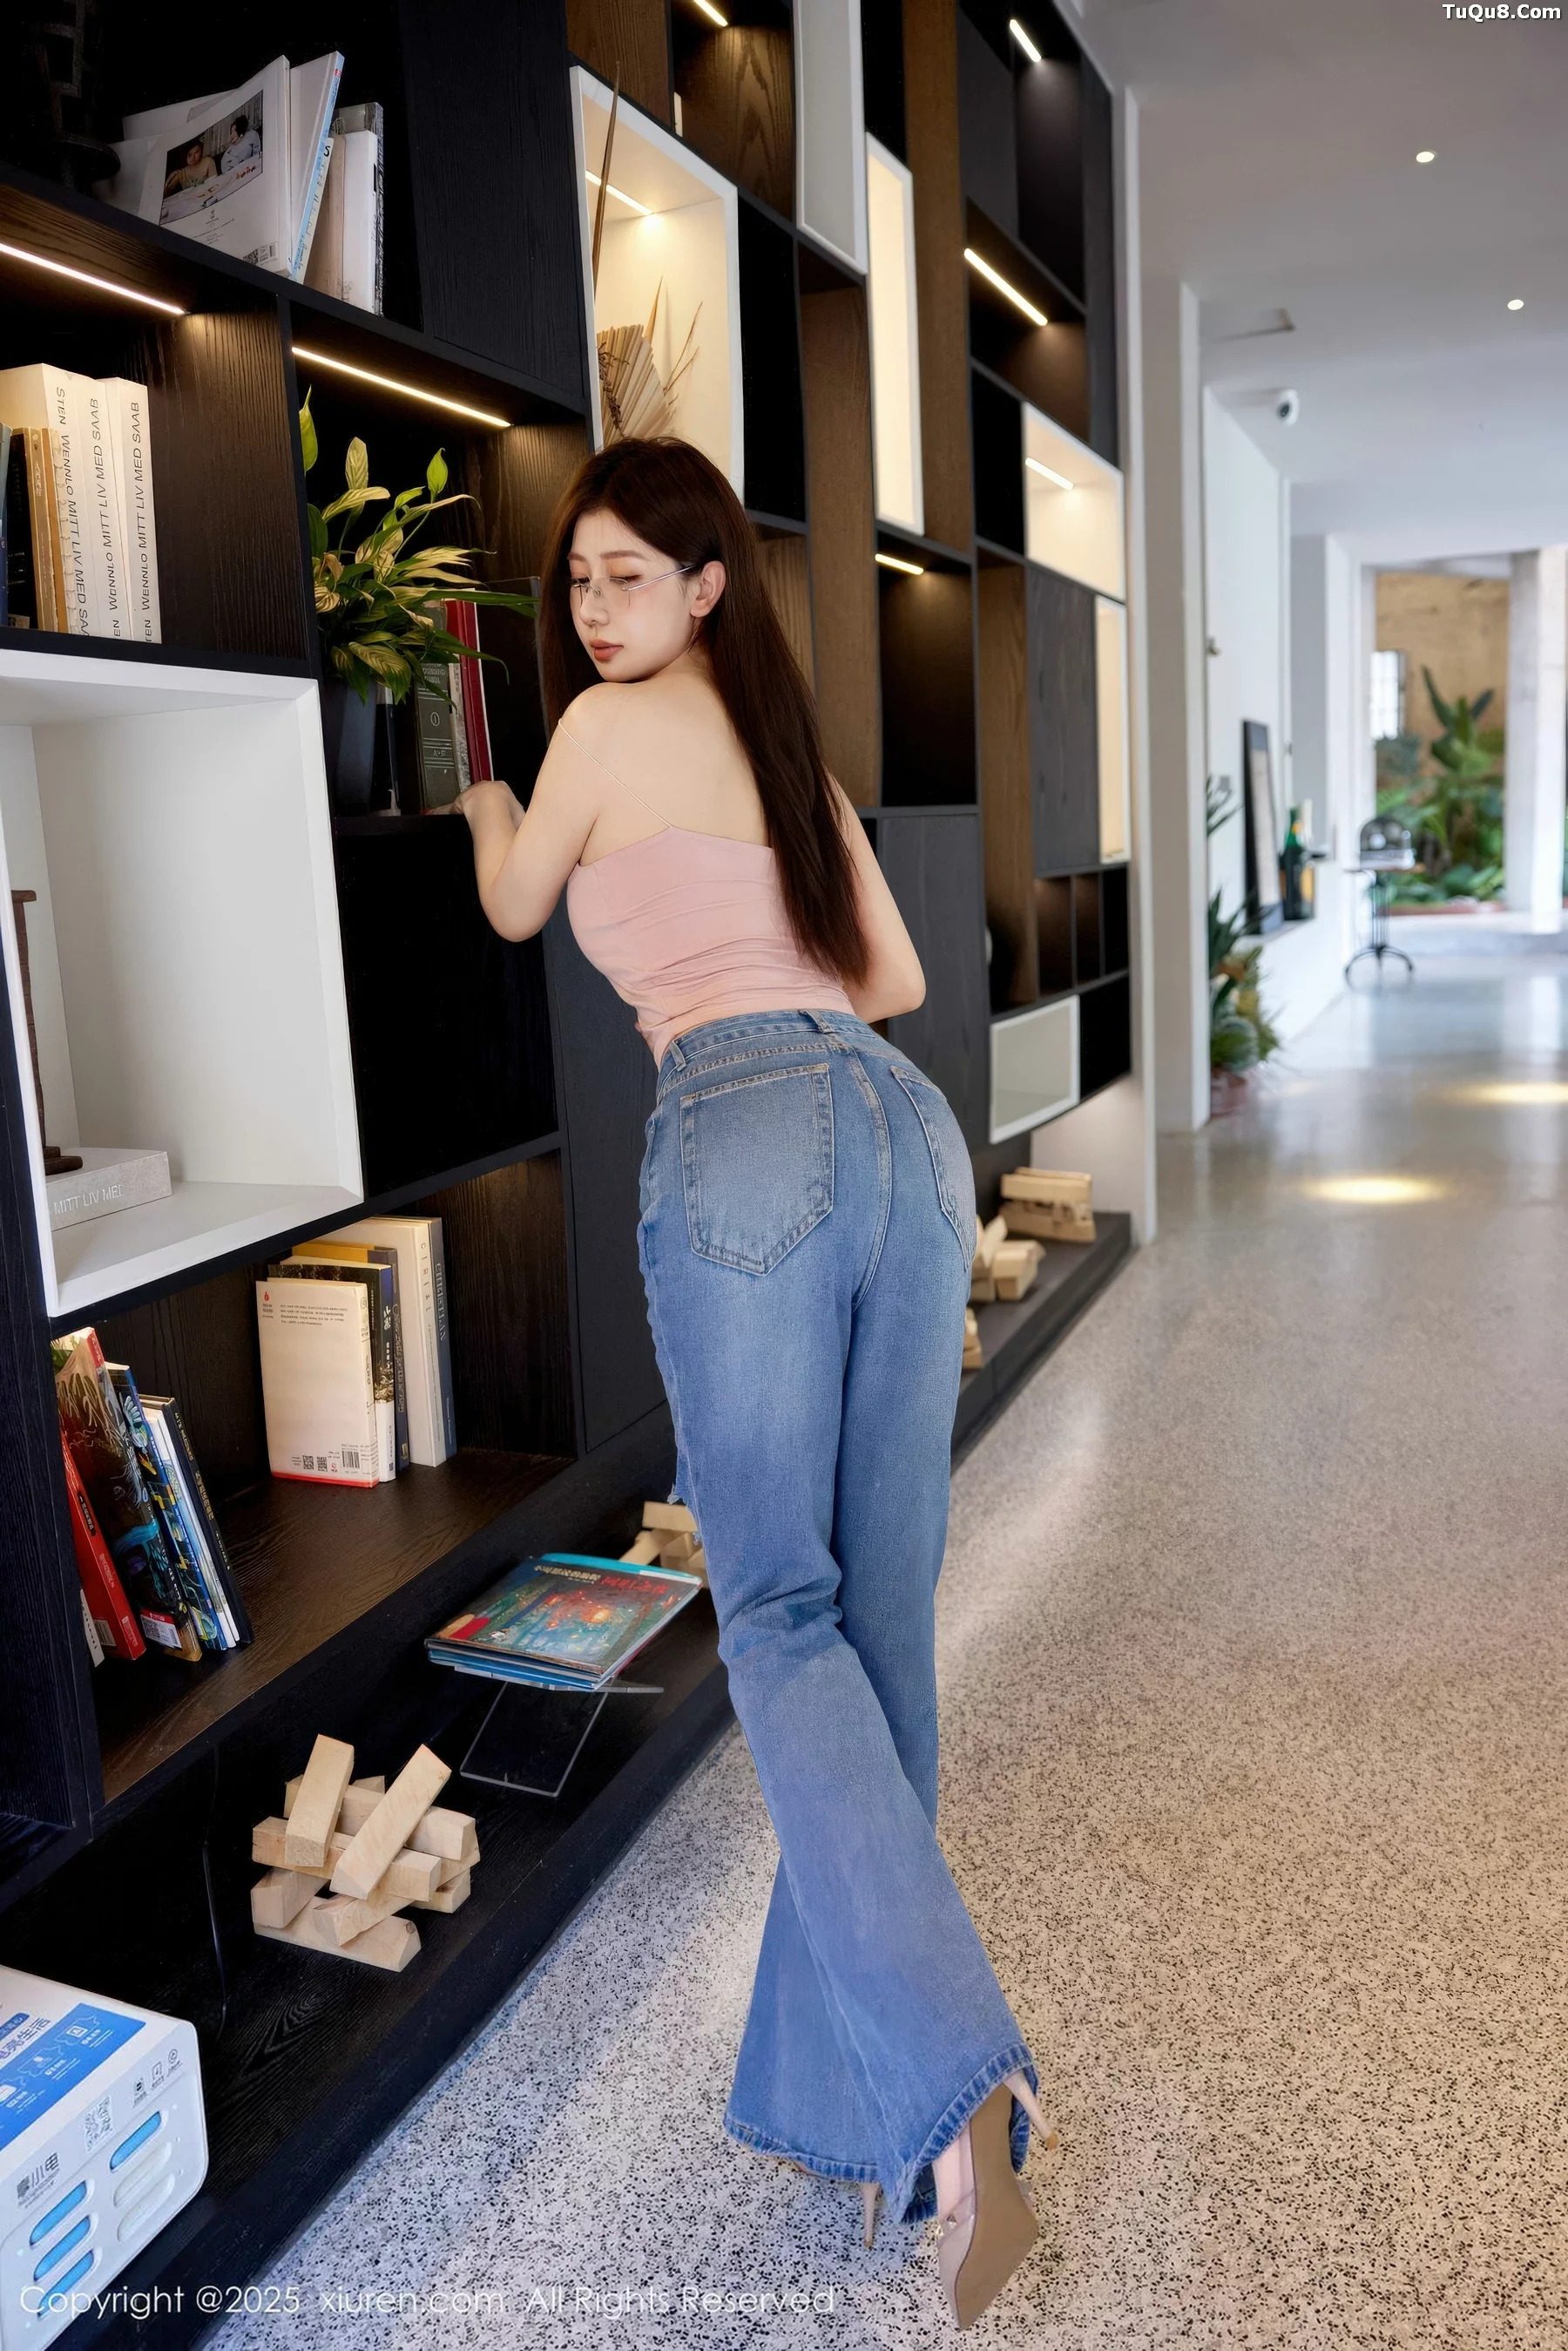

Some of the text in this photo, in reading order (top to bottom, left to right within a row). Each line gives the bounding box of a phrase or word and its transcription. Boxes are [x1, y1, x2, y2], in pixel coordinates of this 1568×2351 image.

[57, 386, 67, 425] STEN
[131, 402, 141, 444] SAAB
[61, 435, 74, 496] WENNLO
[93, 445, 105, 480] MED
[132, 448, 144, 482] MED
[97, 484, 108, 508] LIV
[134, 484, 145, 509] LIV
[68, 499, 80, 538] MITT
[99, 511, 112, 547] MITT
[137, 512, 147, 549] MITT
[72, 541, 84, 566] LIV
[74, 569, 86, 604] MED
[140, 553, 150, 611] WENNLO
[53, 1196, 81, 1216] MITT
[83, 1189, 99, 1207] LIV
